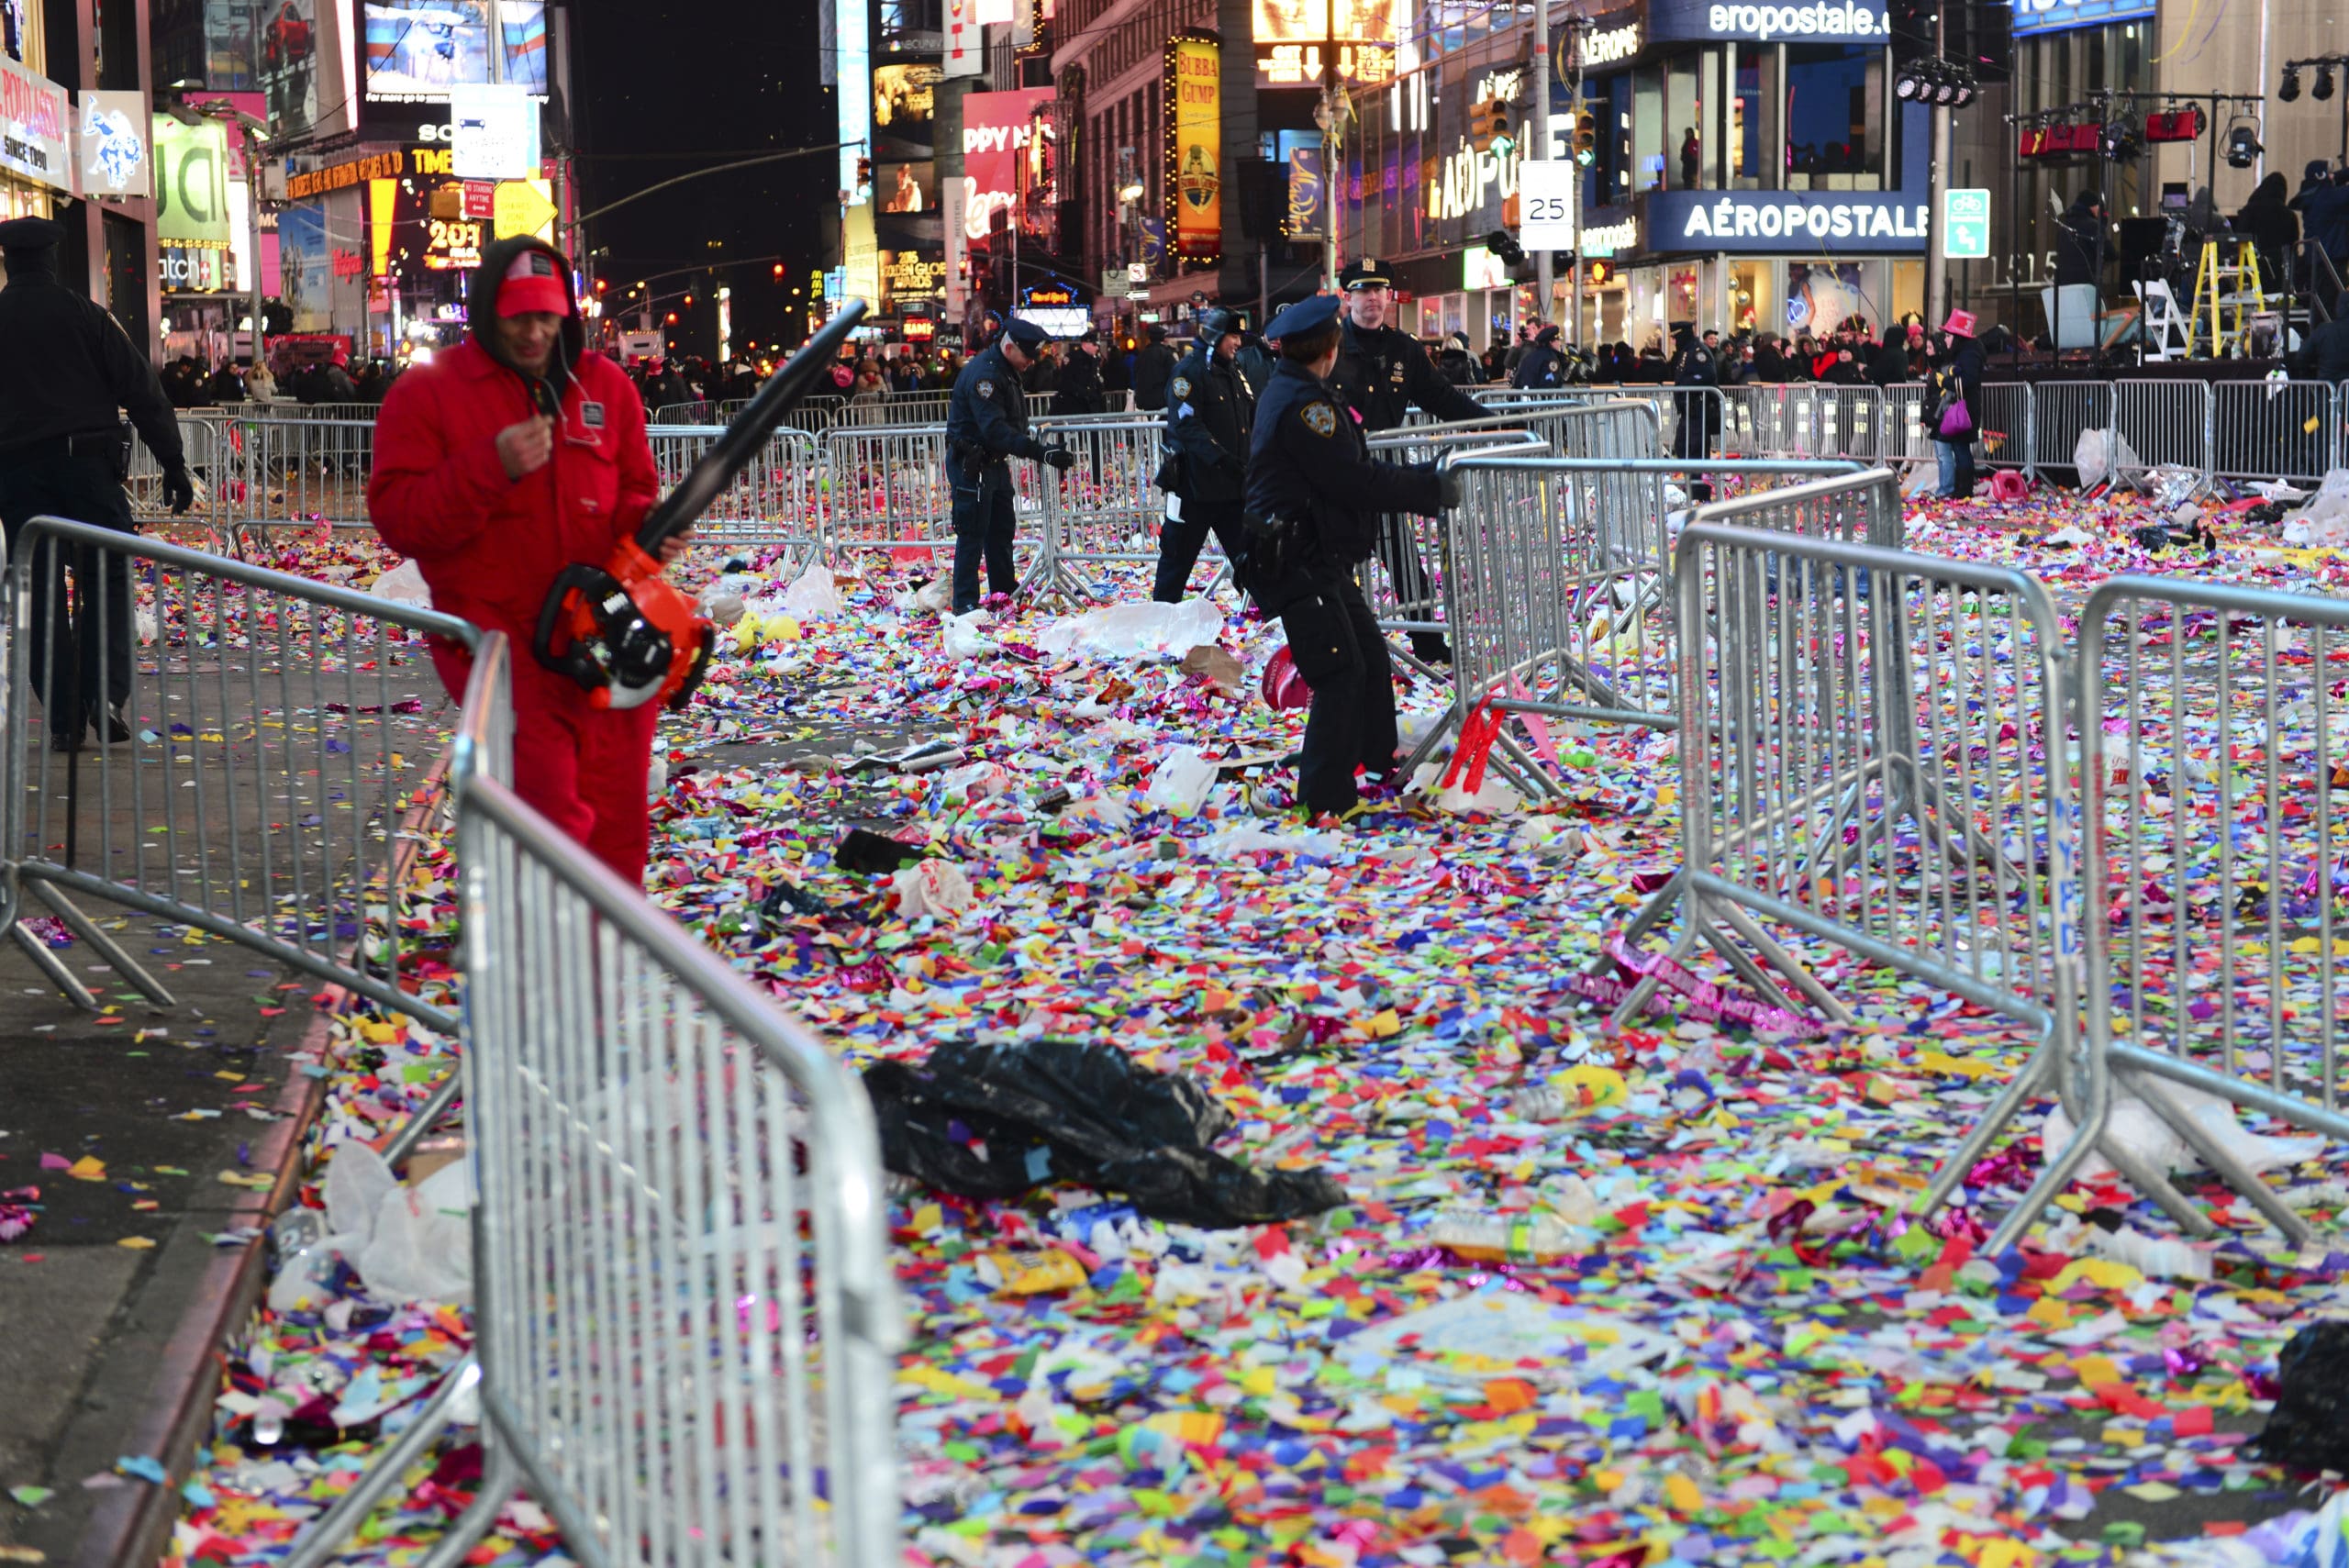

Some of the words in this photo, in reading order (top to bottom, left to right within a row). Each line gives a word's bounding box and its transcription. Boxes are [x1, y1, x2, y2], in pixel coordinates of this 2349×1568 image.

[1179, 51, 1219, 77] BUBBA
[2, 68, 32, 127] POLO
[1182, 80, 1216, 104] GUMP
[4, 136, 28, 163] SINCE
[465, 184, 473, 193] NO
[473, 185, 493, 194] STANDING
[469, 195, 490, 204] ANYTIME
[1530, 198, 1564, 220] 25
[898, 250, 918, 264] 2015
[893, 275, 933, 289] AWARDS
